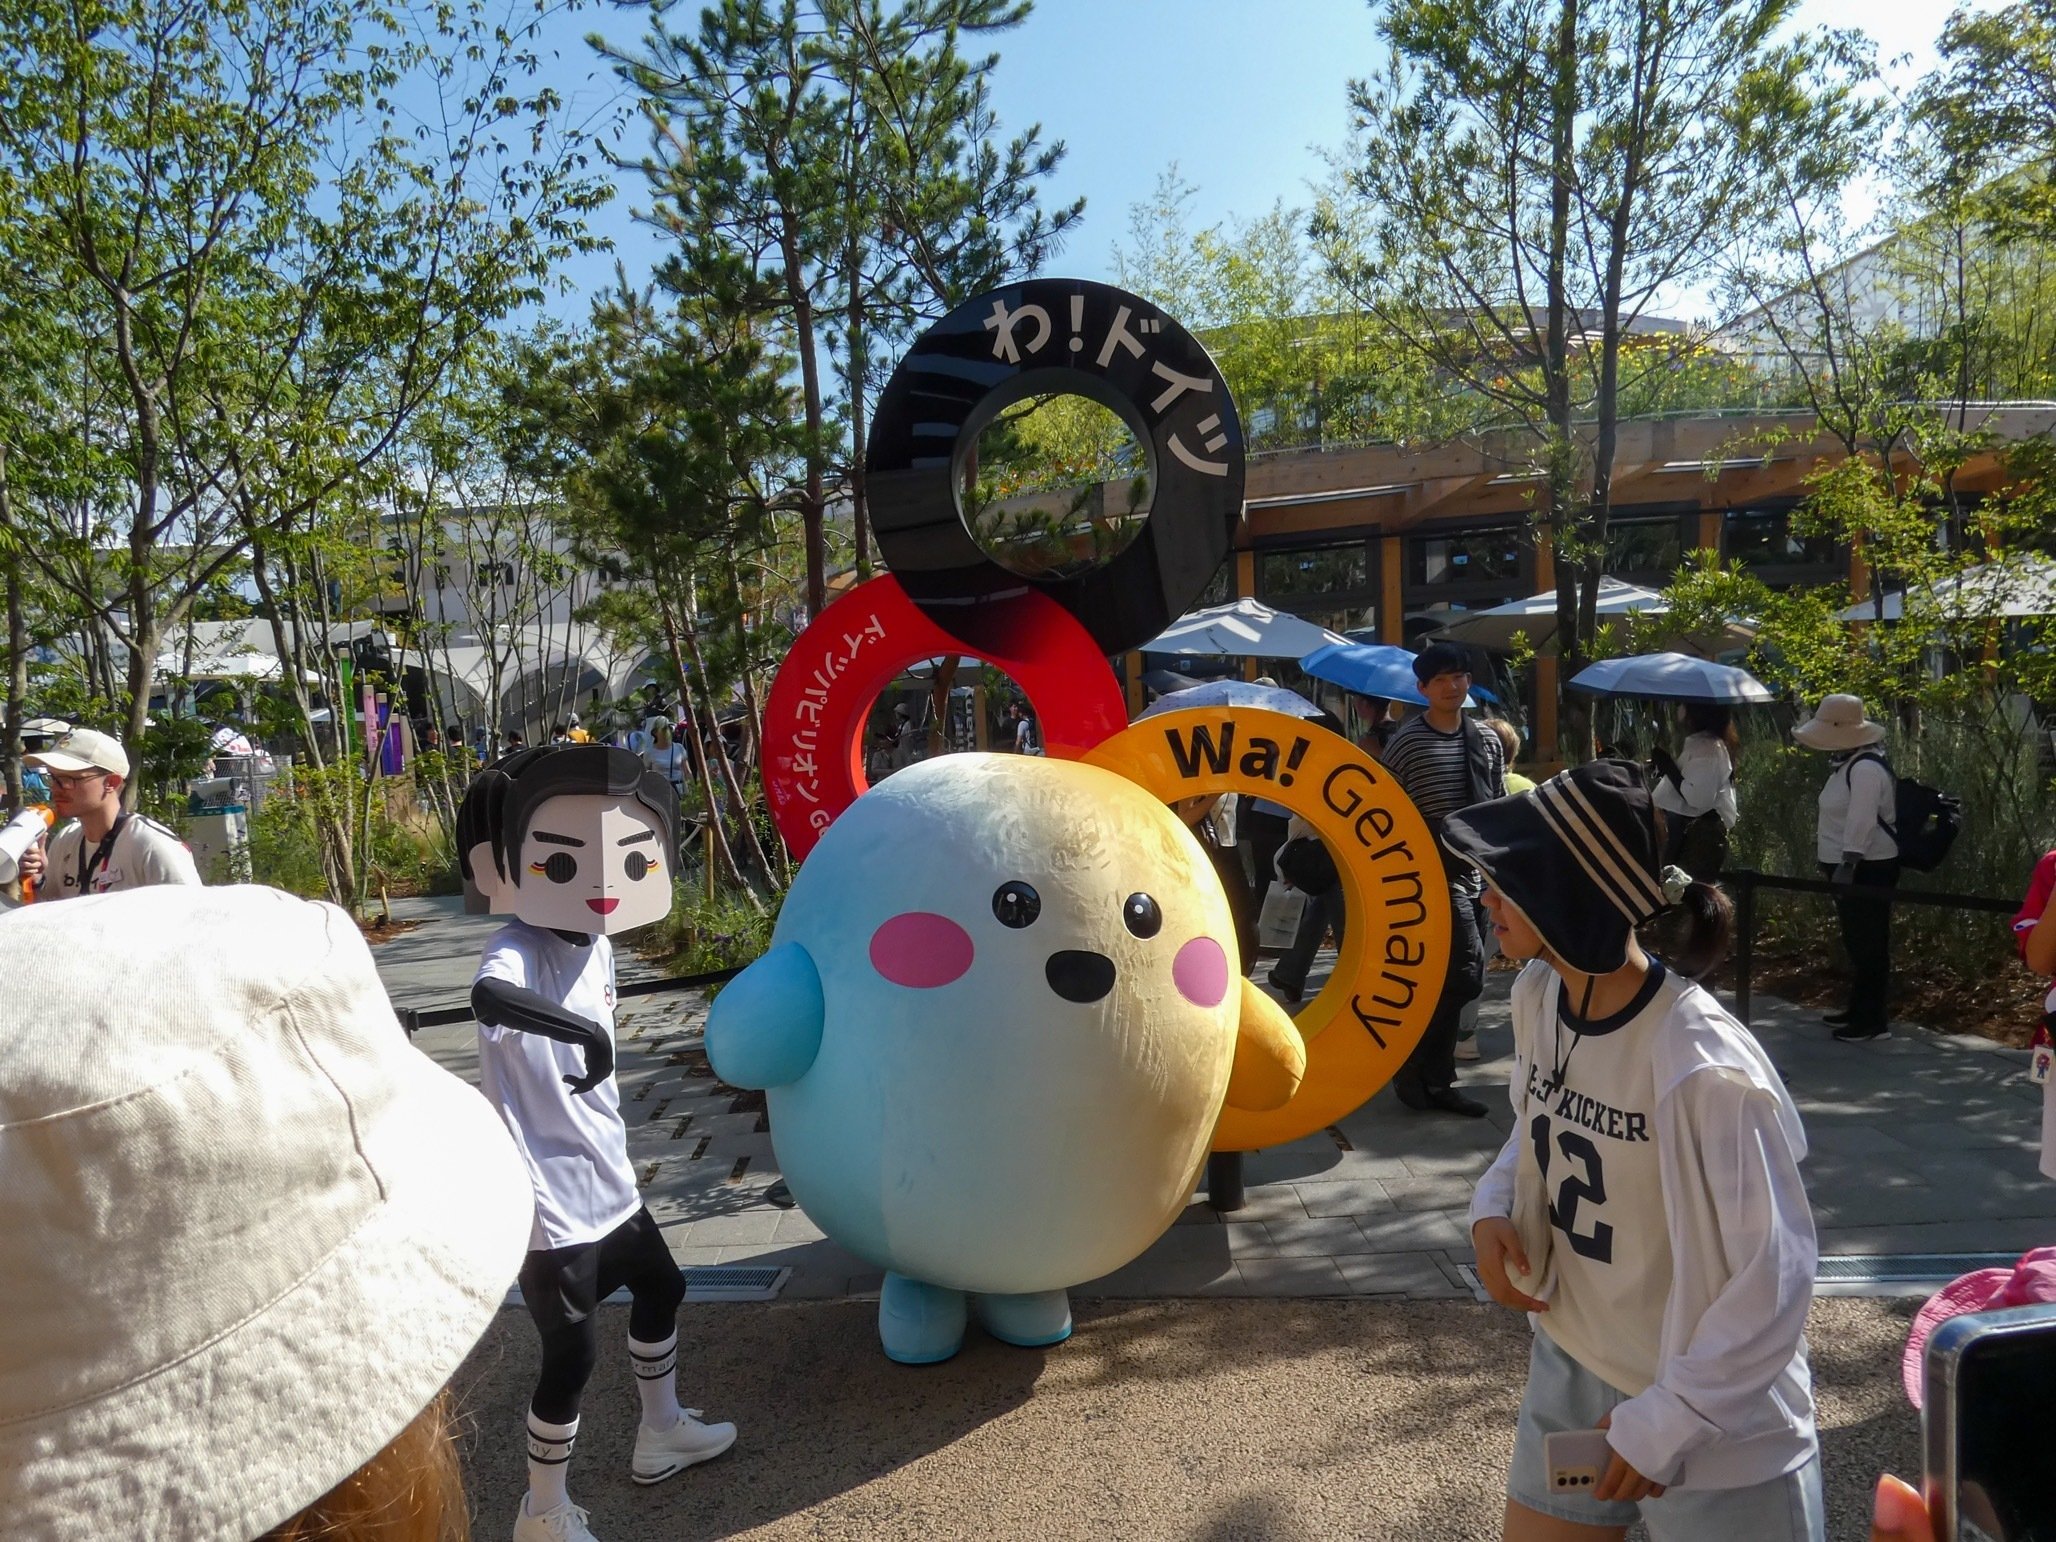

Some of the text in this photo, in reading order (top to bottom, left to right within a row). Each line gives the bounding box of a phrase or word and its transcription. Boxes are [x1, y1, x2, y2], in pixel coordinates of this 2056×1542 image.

[792, 614, 886, 803] ドイツパビリオン
[1164, 721, 1427, 1050] Wa! Germany
[1555, 1089, 1649, 1142] KICKER
